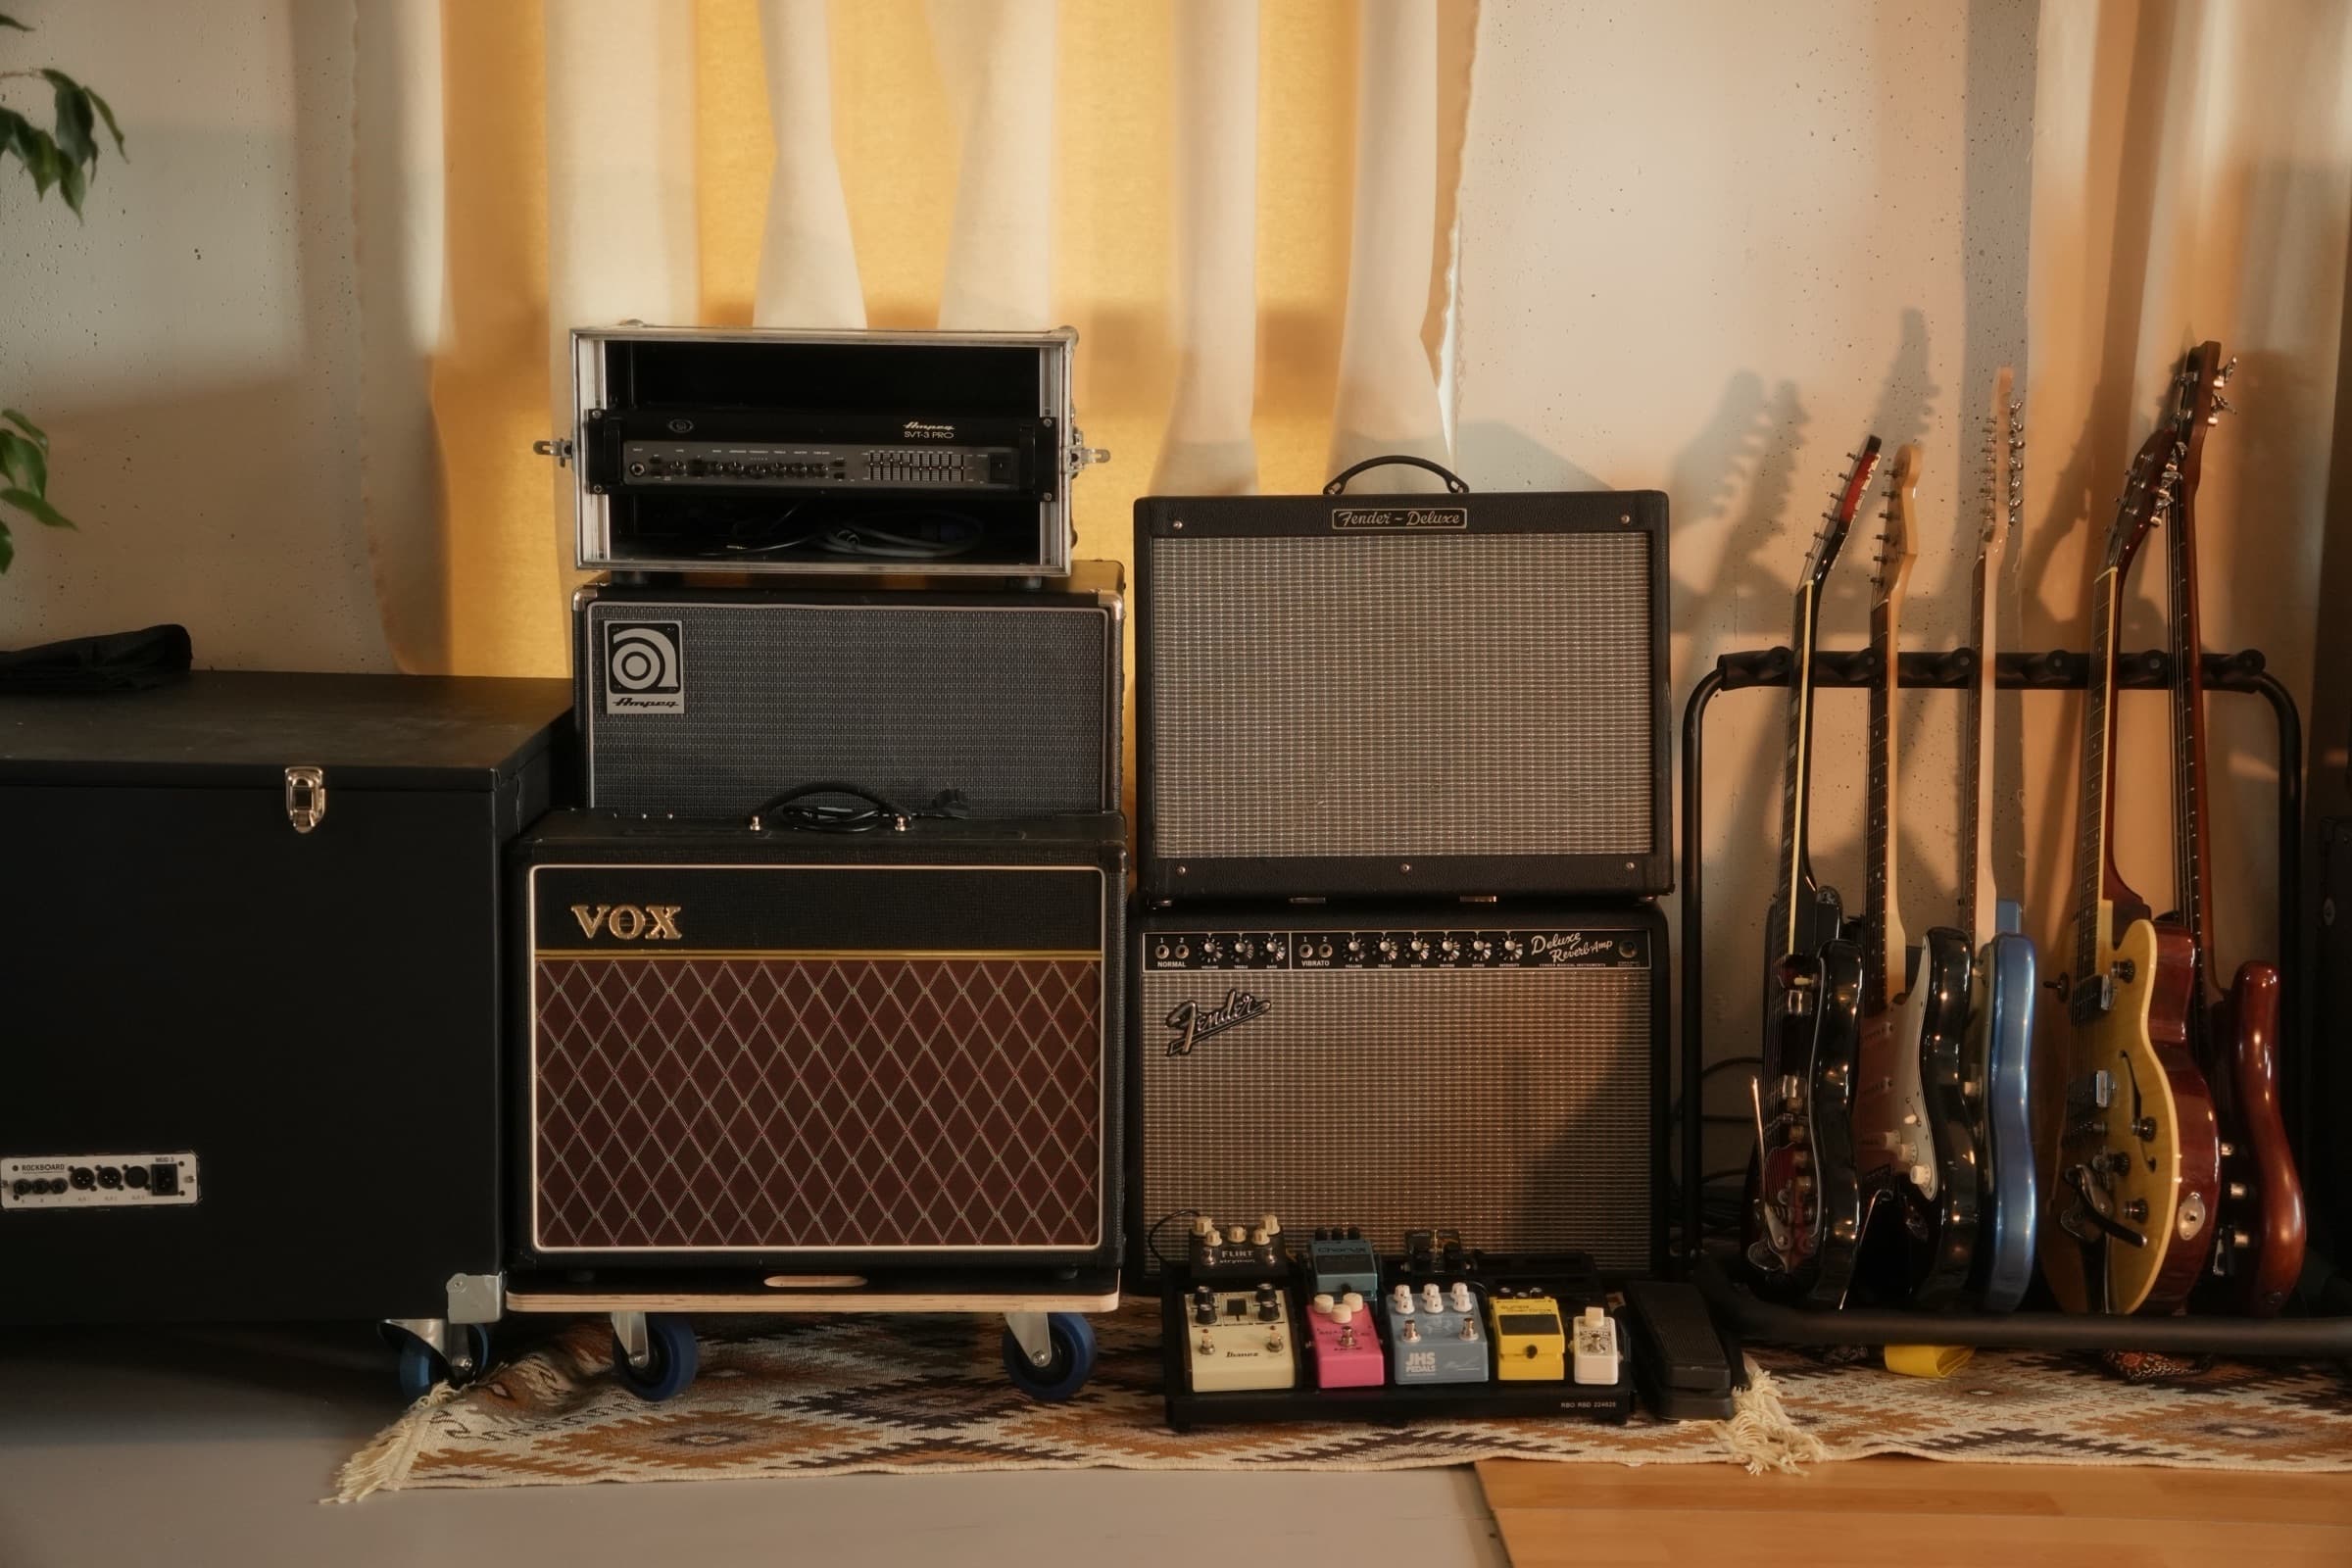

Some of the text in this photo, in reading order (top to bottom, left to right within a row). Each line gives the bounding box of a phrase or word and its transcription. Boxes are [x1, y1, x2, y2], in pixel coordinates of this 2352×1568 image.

[903, 421, 956, 431] Ampeg
[1339, 511, 1392, 526] Fender
[1406, 511, 1460, 526] Deluxe
[612, 697, 680, 708] Ampeg
[570, 905, 683, 940] VOX
[1531, 932, 1582, 956] Deluxe
[1165, 989, 1271, 1056] Fender
[22, 1163, 65, 1172] ROCKBOARD
[1405, 1351, 1436, 1367] JHS
[1405, 1364, 1436, 1373] PEDALS
